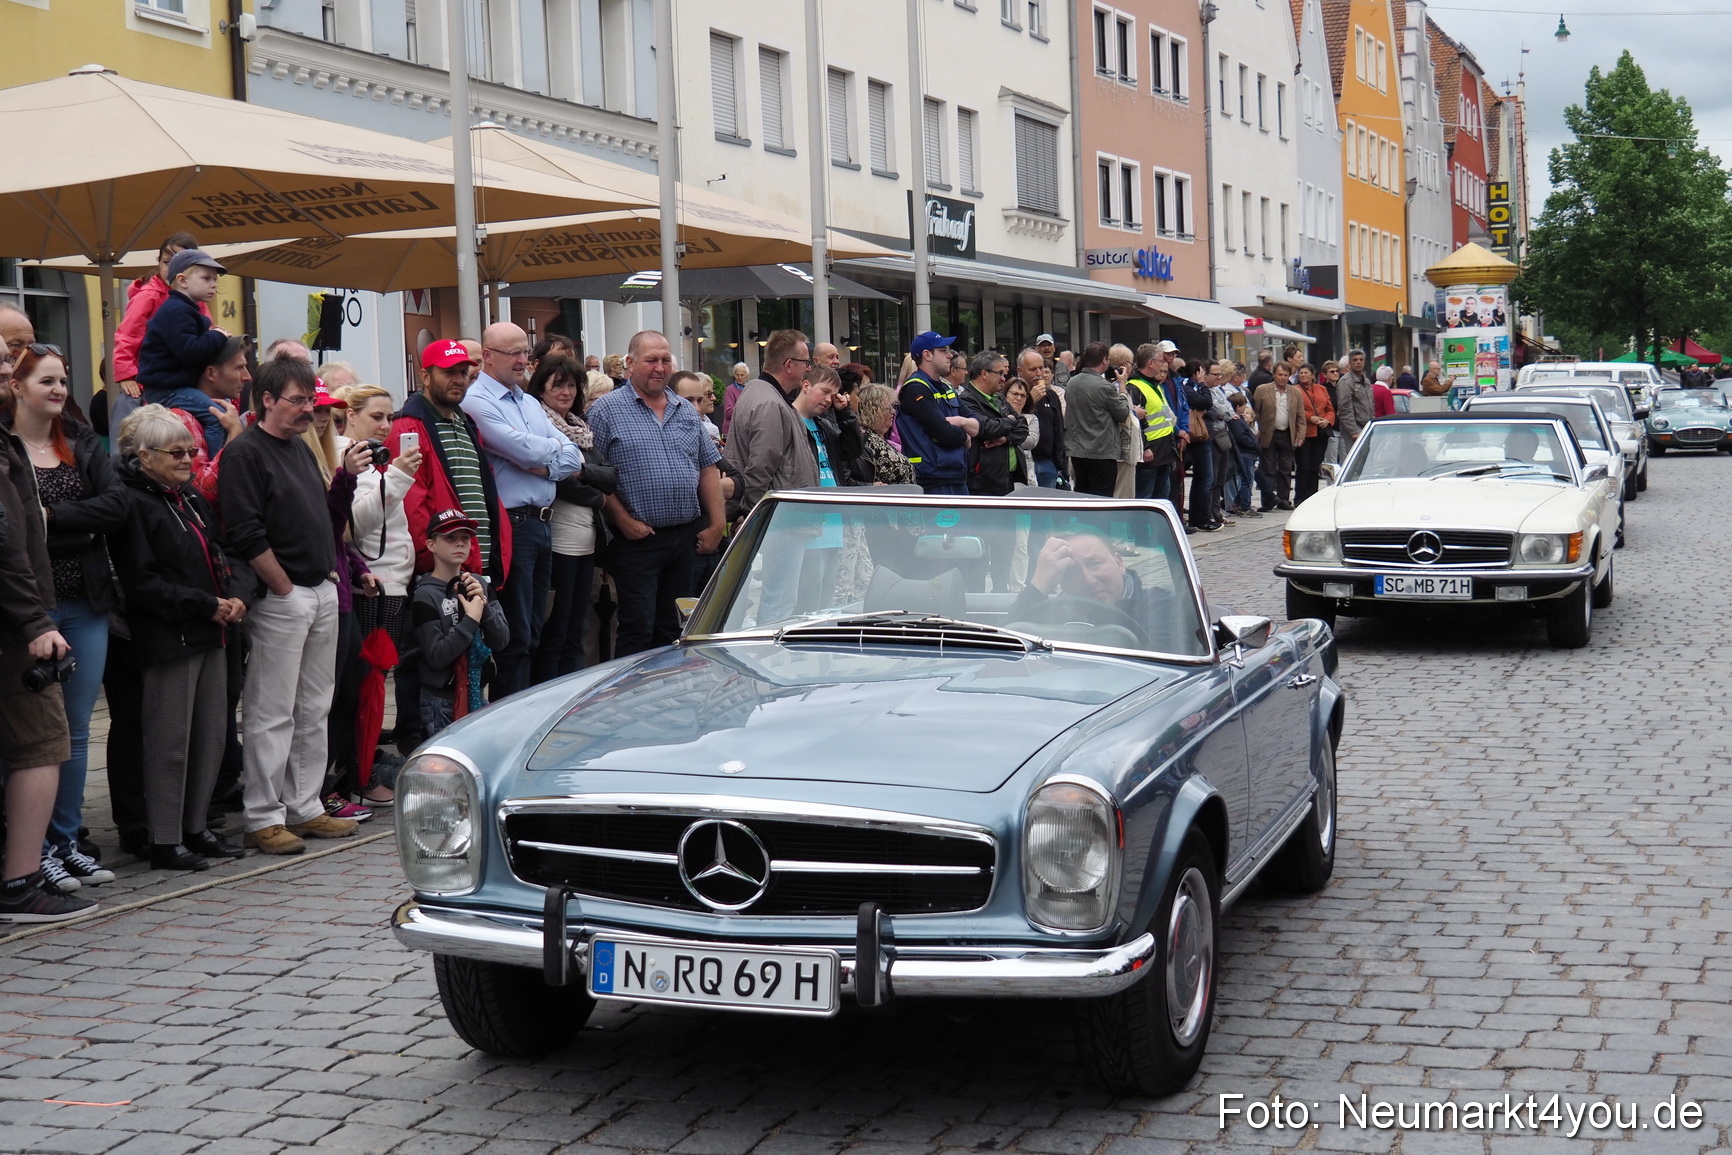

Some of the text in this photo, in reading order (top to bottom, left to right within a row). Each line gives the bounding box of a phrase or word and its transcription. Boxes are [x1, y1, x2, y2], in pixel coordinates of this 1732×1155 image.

[1489, 184, 1509, 257] HOT
[221, 299, 236, 318] 24
[438, 508, 454, 521] NEW
[1385, 577, 1404, 593] SC
[1414, 578, 1435, 593] MB
[599, 949, 820, 1002] D N RQ 69 H
